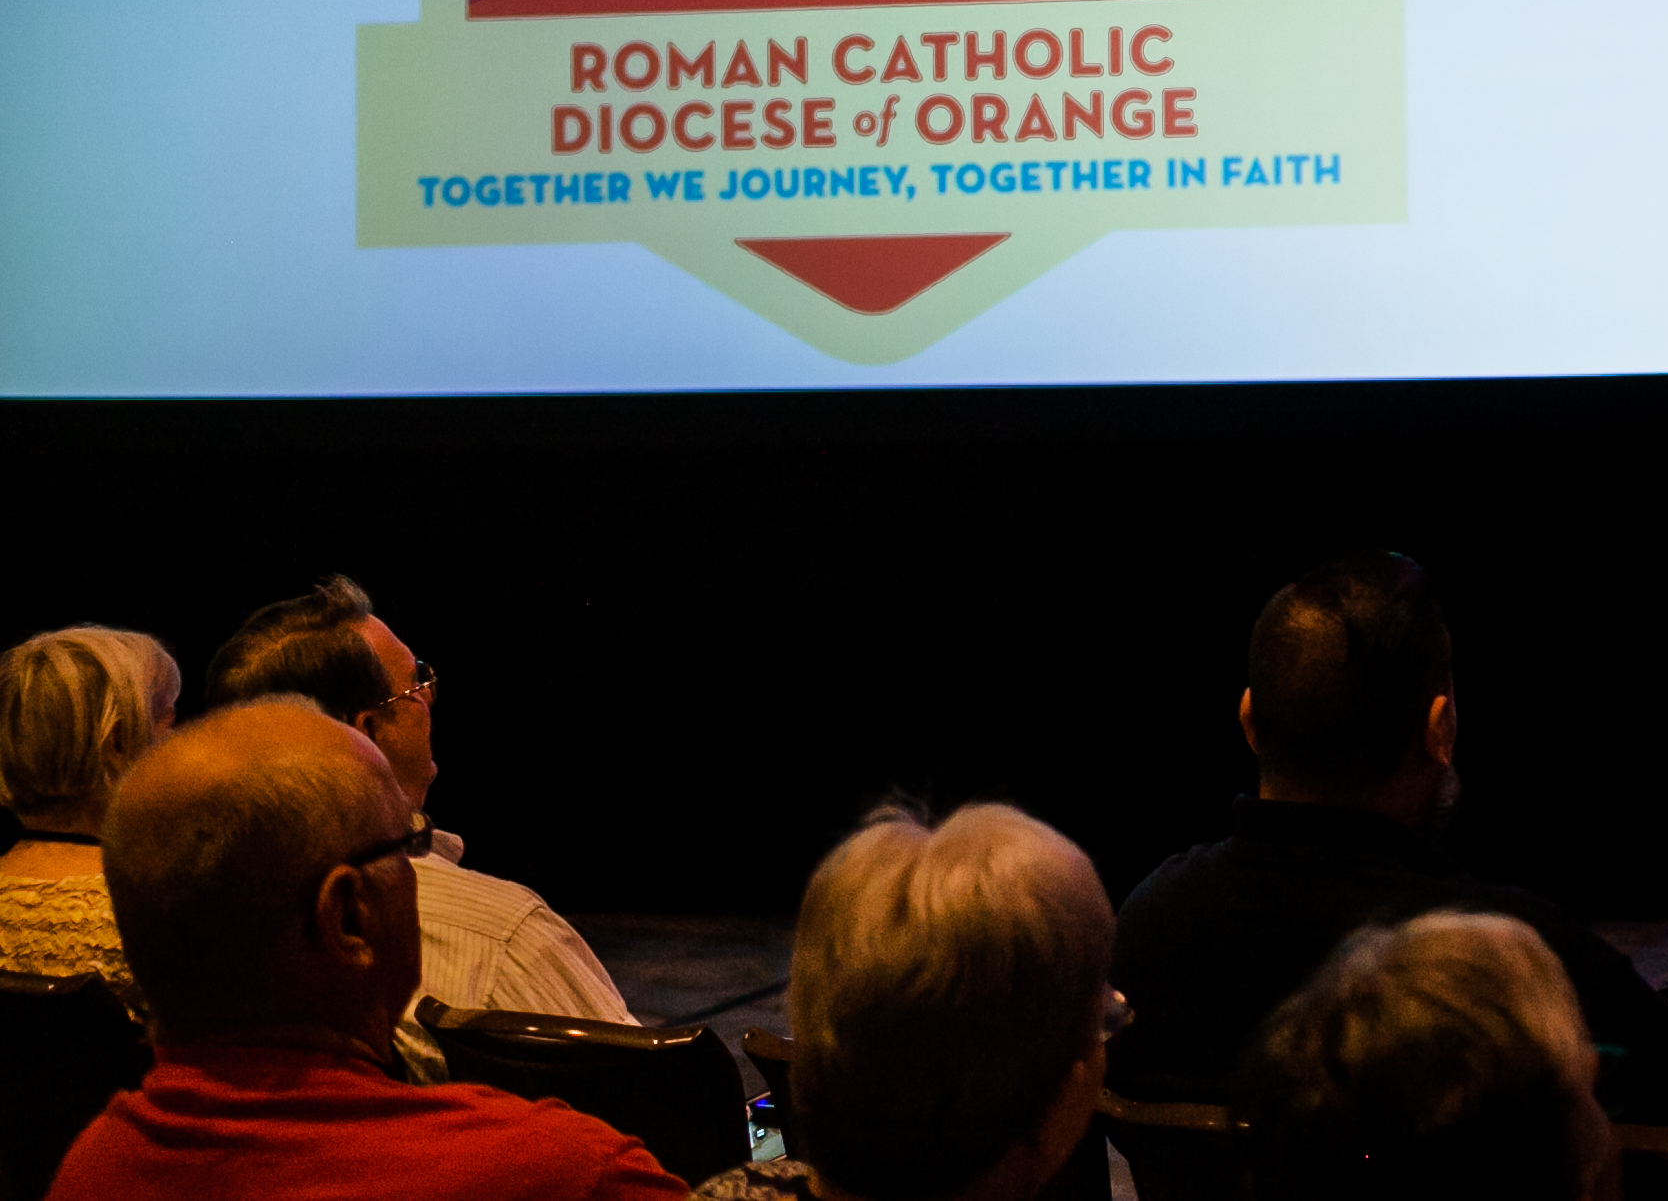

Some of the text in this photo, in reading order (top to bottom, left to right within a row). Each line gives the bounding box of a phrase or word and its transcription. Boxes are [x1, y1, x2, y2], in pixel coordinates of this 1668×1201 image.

[570, 24, 1175, 93] ROMAN CATHOLIC
[551, 87, 1198, 155] DIOCESE of ORANGE
[418, 153, 1341, 208] TOGETHER WE JOURNEY, TOGETHER IN FAITH
